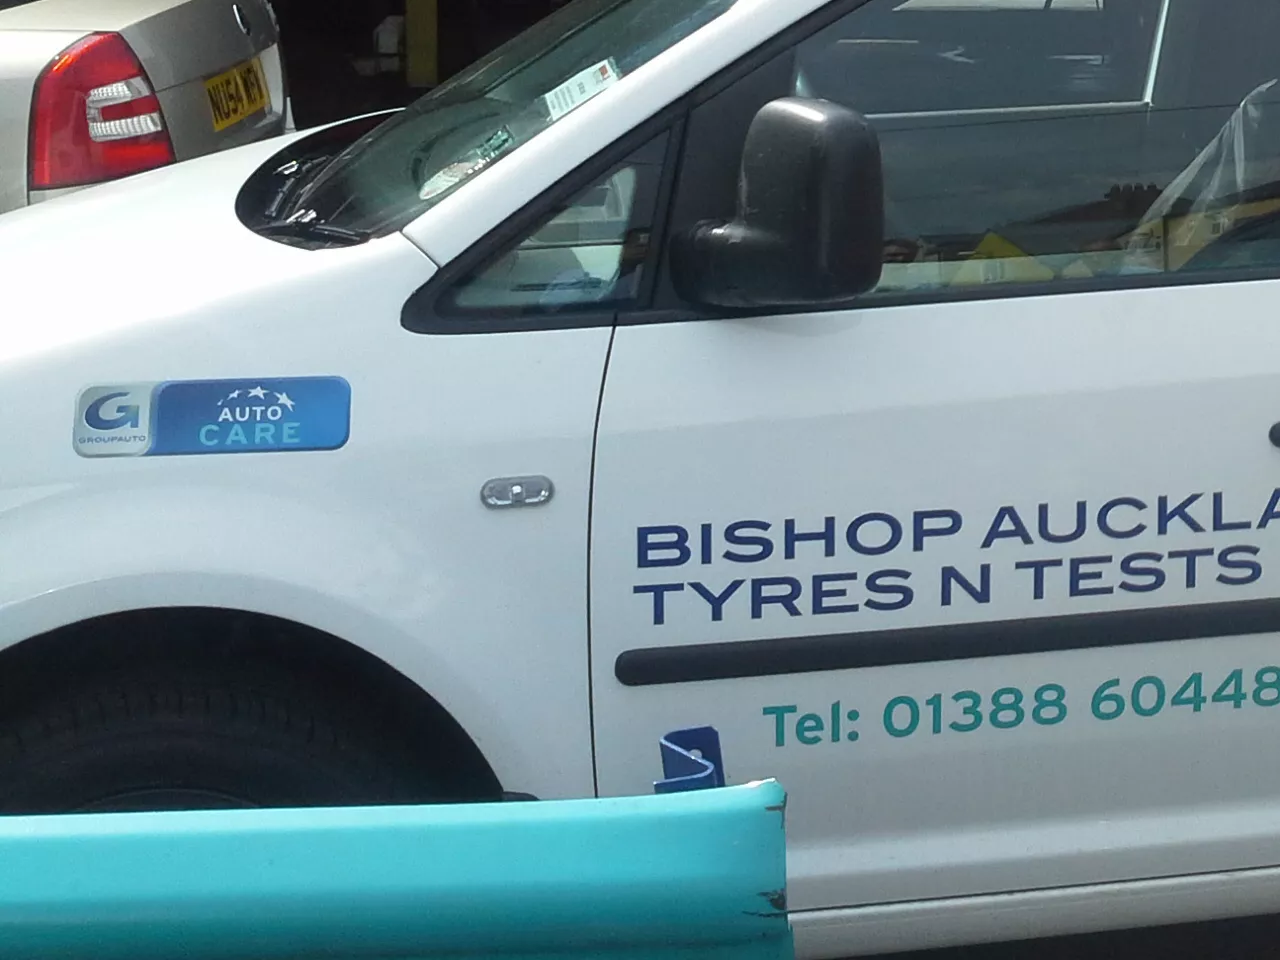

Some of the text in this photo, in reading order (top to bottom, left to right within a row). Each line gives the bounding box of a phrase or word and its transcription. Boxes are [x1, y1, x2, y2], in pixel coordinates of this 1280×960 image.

[199, 422, 301, 446] CARE
[218, 405, 283, 422] AUTO
[78, 435, 147, 445] GROUPAUTO
[636, 509, 963, 569] BISHOP
[633, 568, 914, 626] TYRES
[941, 564, 990, 606] N
[1015, 544, 1263, 601] TESTS
[763, 700, 859, 747] Tel:
[883, 684, 1067, 737] 01388
